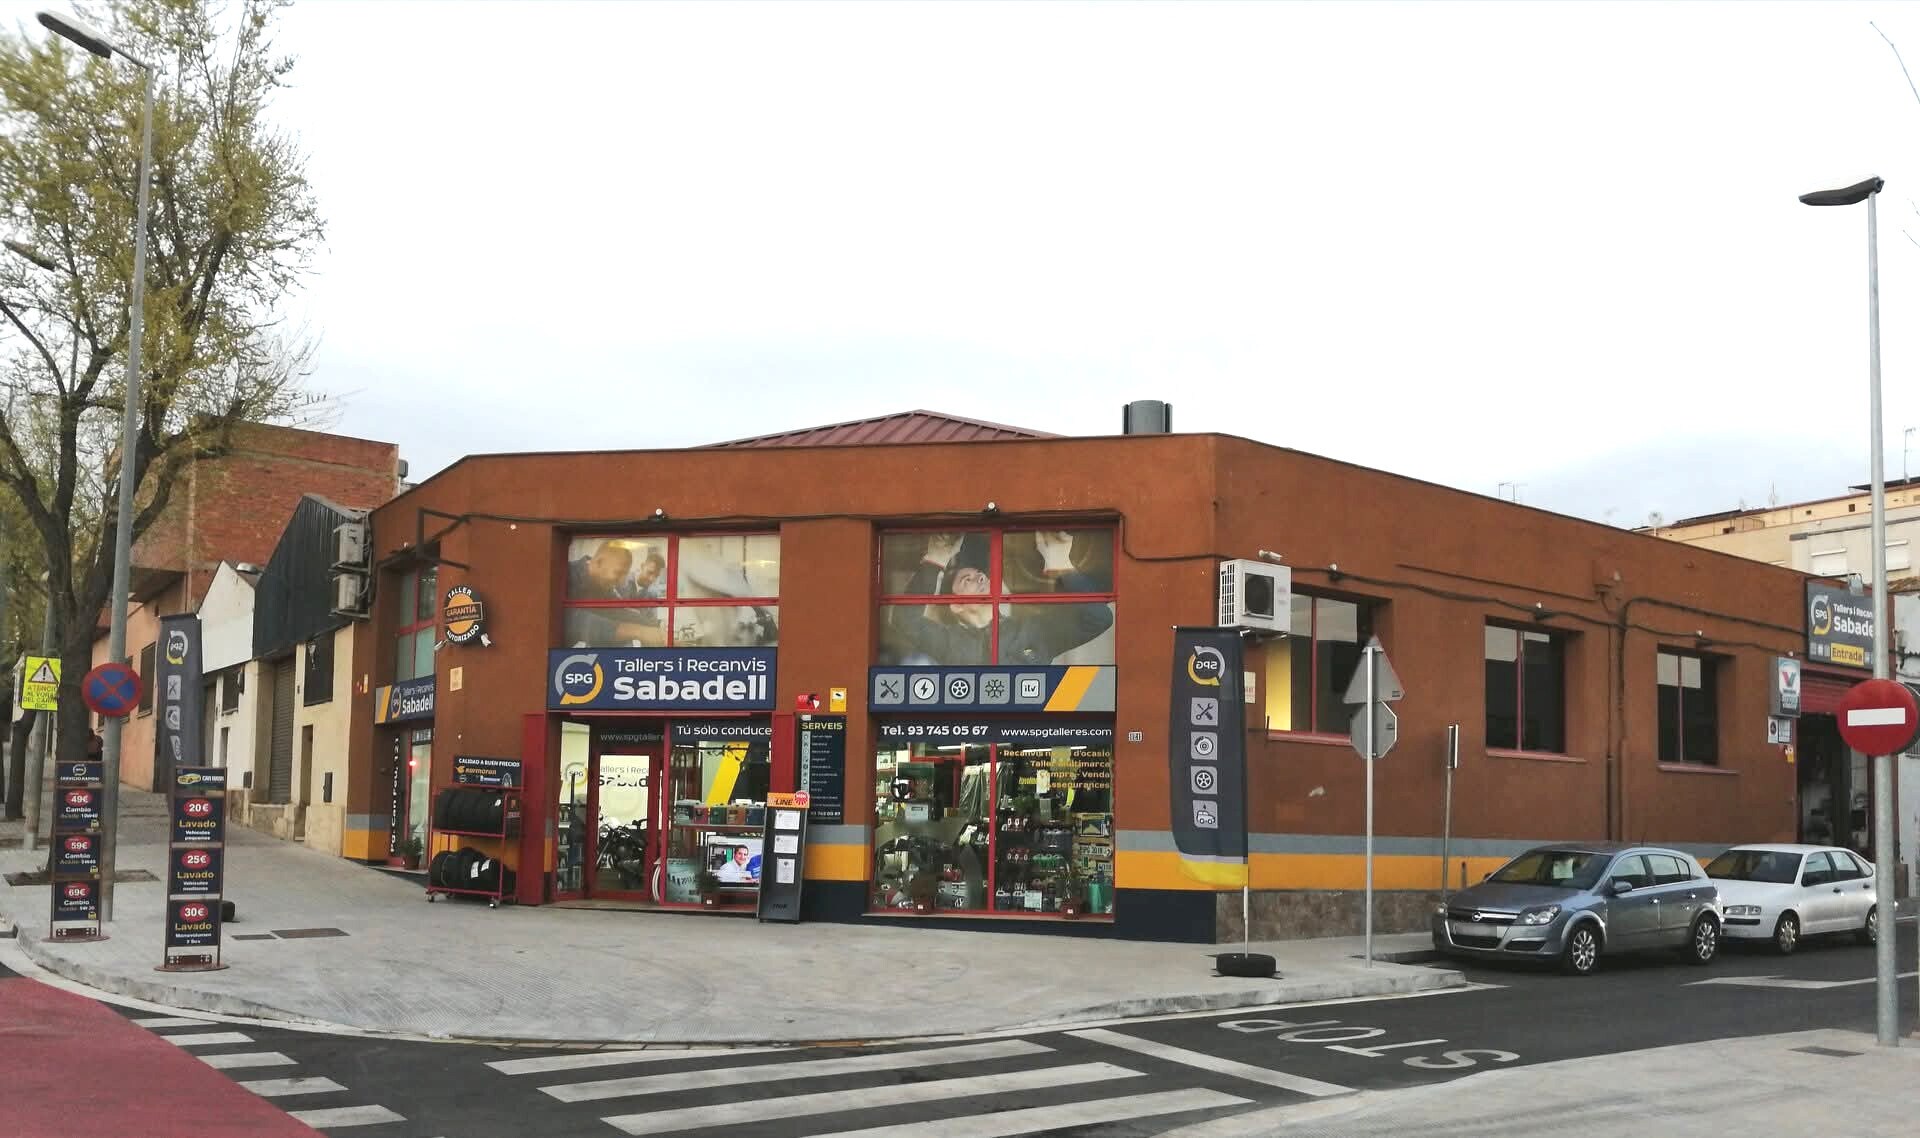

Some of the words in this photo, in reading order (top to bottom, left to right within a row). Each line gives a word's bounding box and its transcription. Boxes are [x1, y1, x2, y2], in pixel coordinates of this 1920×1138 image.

[447, 586, 472, 599] TALLER
[1815, 609, 1828, 620] SPG
[1833, 603, 1853, 615] Tallers
[446, 624, 480, 642] AUTORIZADO
[1832, 647, 1864, 662] Entrada
[614, 656, 674, 672] Tallers
[678, 656, 683, 672] i
[687, 656, 767, 673] Recanvis
[565, 673, 593, 684] SPG
[613, 674, 767, 701] Sabadell
[676, 724, 691, 735] Tú
[693, 724, 719, 735] sólo
[721, 725, 773, 735] conduce
[801, 722, 843, 730] SERVEIS
[881, 725, 904, 736] Tel.
[907, 725, 924, 736] 93
[926, 725, 950, 736] 745
[952, 725, 970, 736] 05
[972, 725, 989, 736] 67
[1001, 727, 1112, 738] www.spgtalleres.com
[71, 795, 88, 803] 49€
[179, 820, 216, 828] Lavado
[71, 841, 88, 850] 59€
[187, 855, 206, 864] 25€
[177, 871, 214, 879] Lavado
[68, 888, 86, 897] 69€
[184, 908, 204, 917] 30€
[174, 923, 212, 931] Lavado
[1216, 1018, 1521, 1069] STOP
